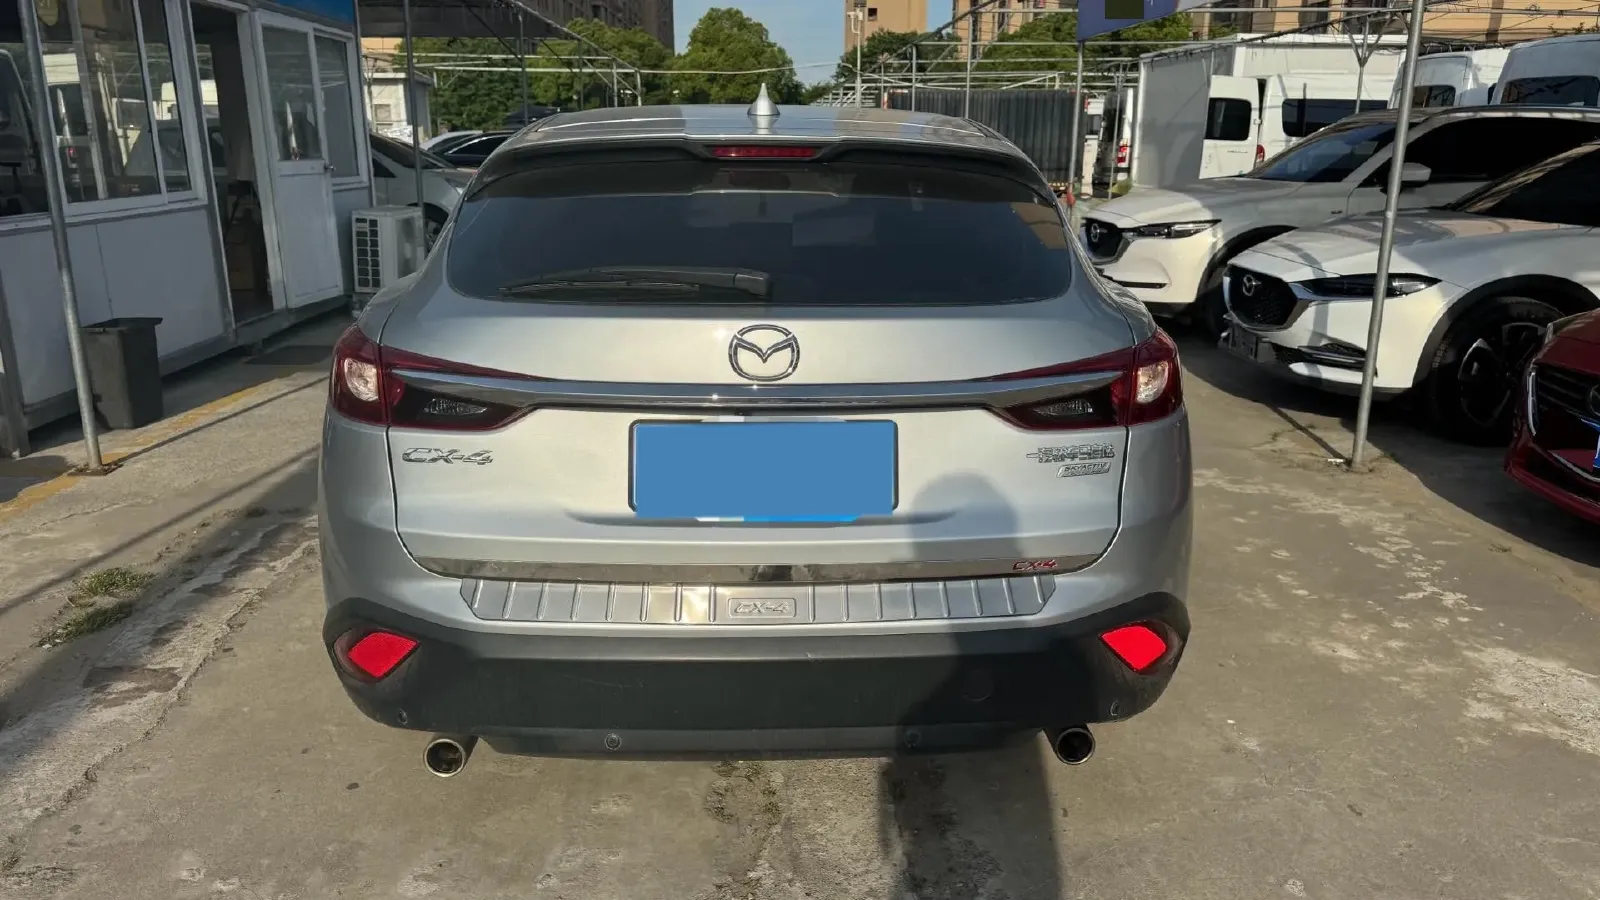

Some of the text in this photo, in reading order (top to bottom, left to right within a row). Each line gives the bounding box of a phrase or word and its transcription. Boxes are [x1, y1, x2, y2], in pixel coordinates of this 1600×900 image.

[402, 447, 494, 466] CX-4
[1064, 464, 1105, 472] SKYACTIV
[734, 602, 788, 614] CX-4
